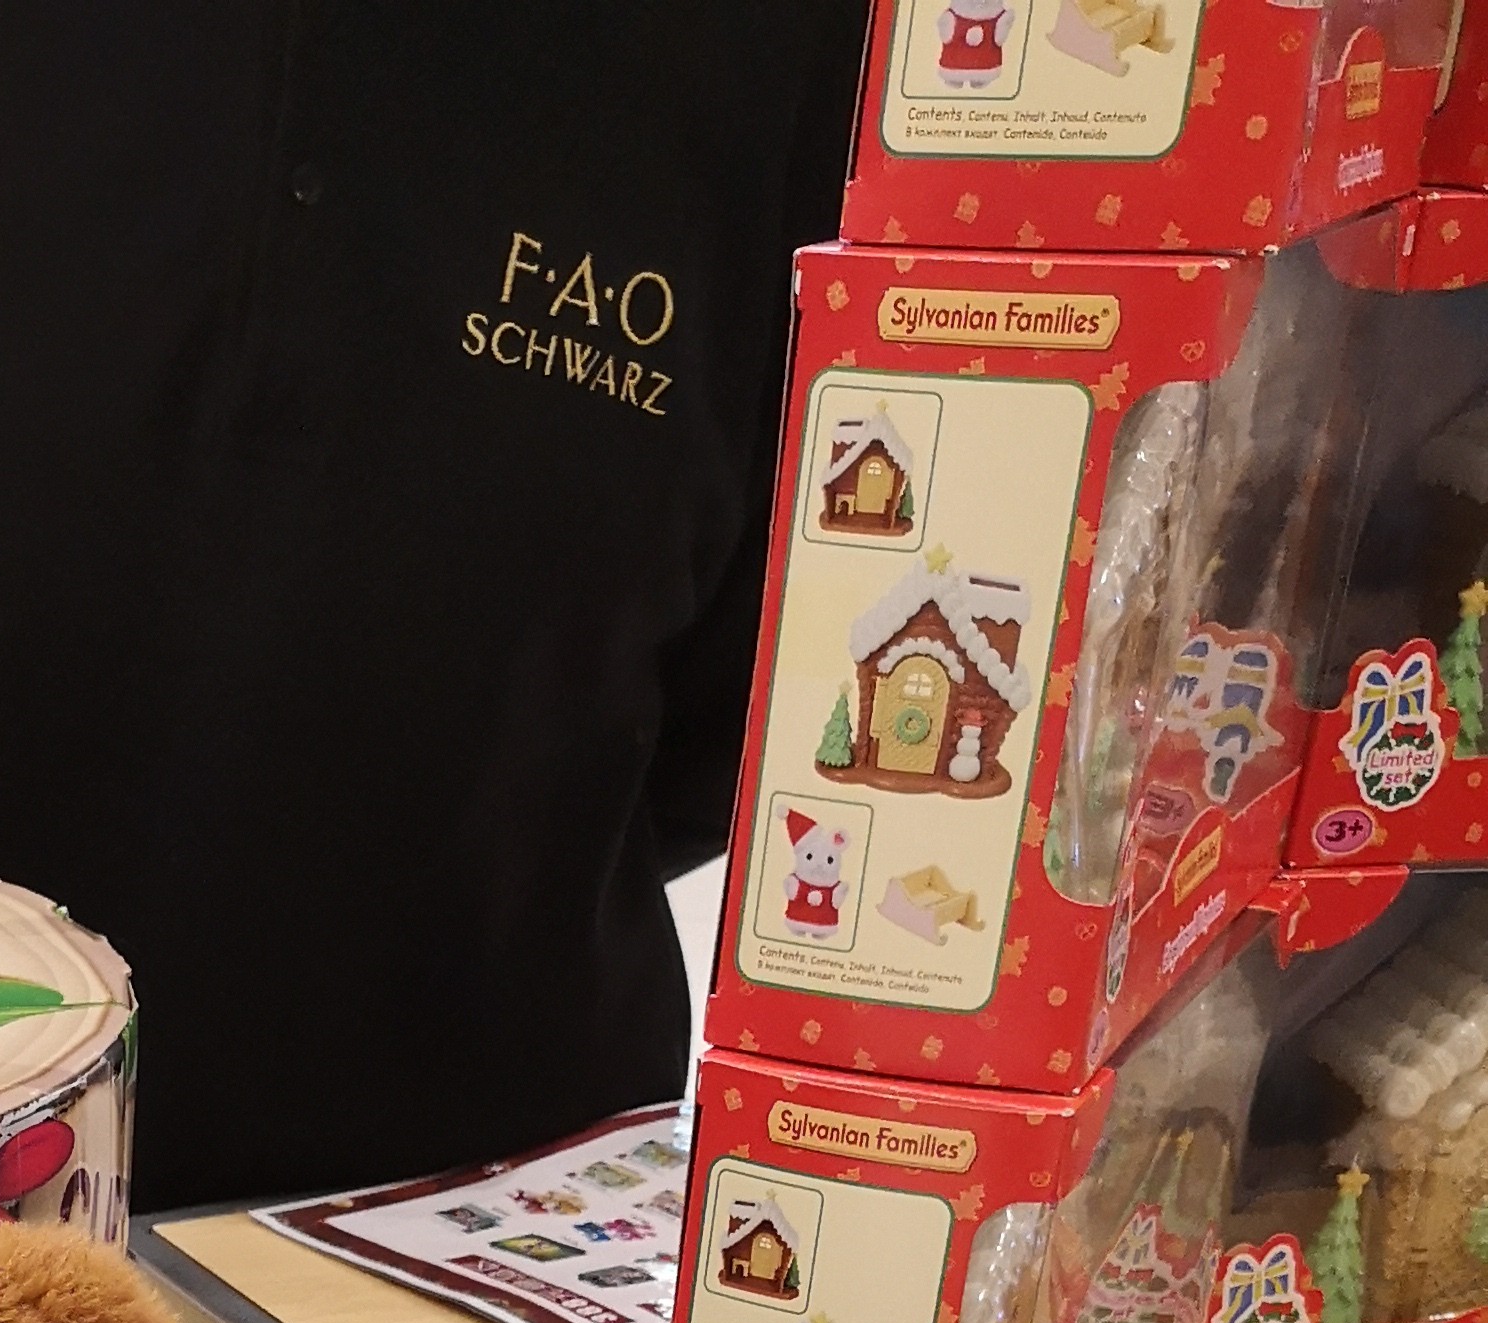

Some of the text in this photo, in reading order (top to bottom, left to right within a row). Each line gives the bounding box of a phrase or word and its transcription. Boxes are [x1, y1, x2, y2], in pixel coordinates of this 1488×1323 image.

[890, 296, 997, 335] Sylvanian
[462, 312, 673, 416] SCHWARZ
[1369, 750, 1435, 769] Limited
[1384, 769, 1412, 786] set
[1324, 818, 1364, 842] 3+
[778, 1108, 870, 1149] Sylvanian
